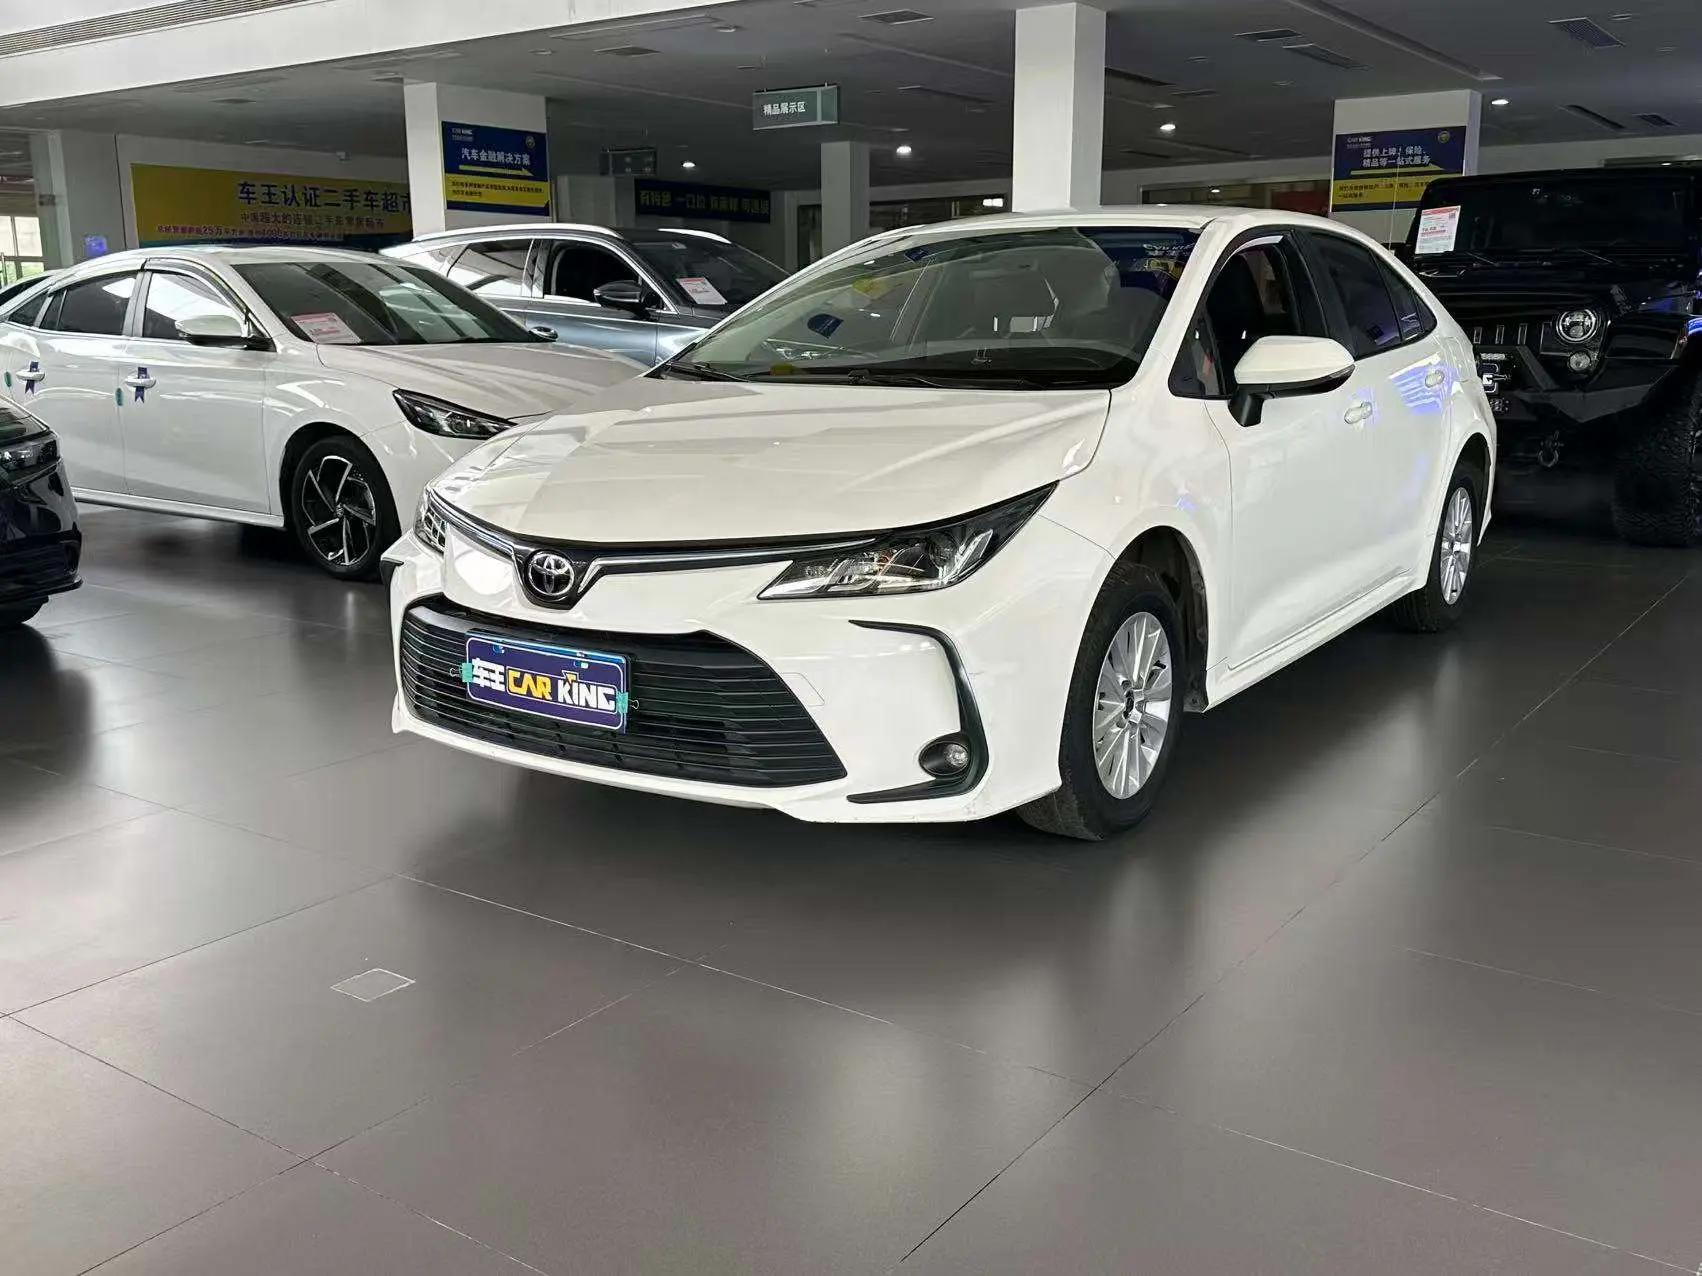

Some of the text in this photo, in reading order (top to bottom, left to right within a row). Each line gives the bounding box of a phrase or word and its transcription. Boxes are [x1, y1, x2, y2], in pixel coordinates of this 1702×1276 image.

[762, 101, 806, 116] 精品展示区
[461, 147, 531, 165] 汽车金融解决方案
[1361, 155, 1431, 167] 精品等一站式服务
[471, 657, 616, 712] 车王 CAR KING
